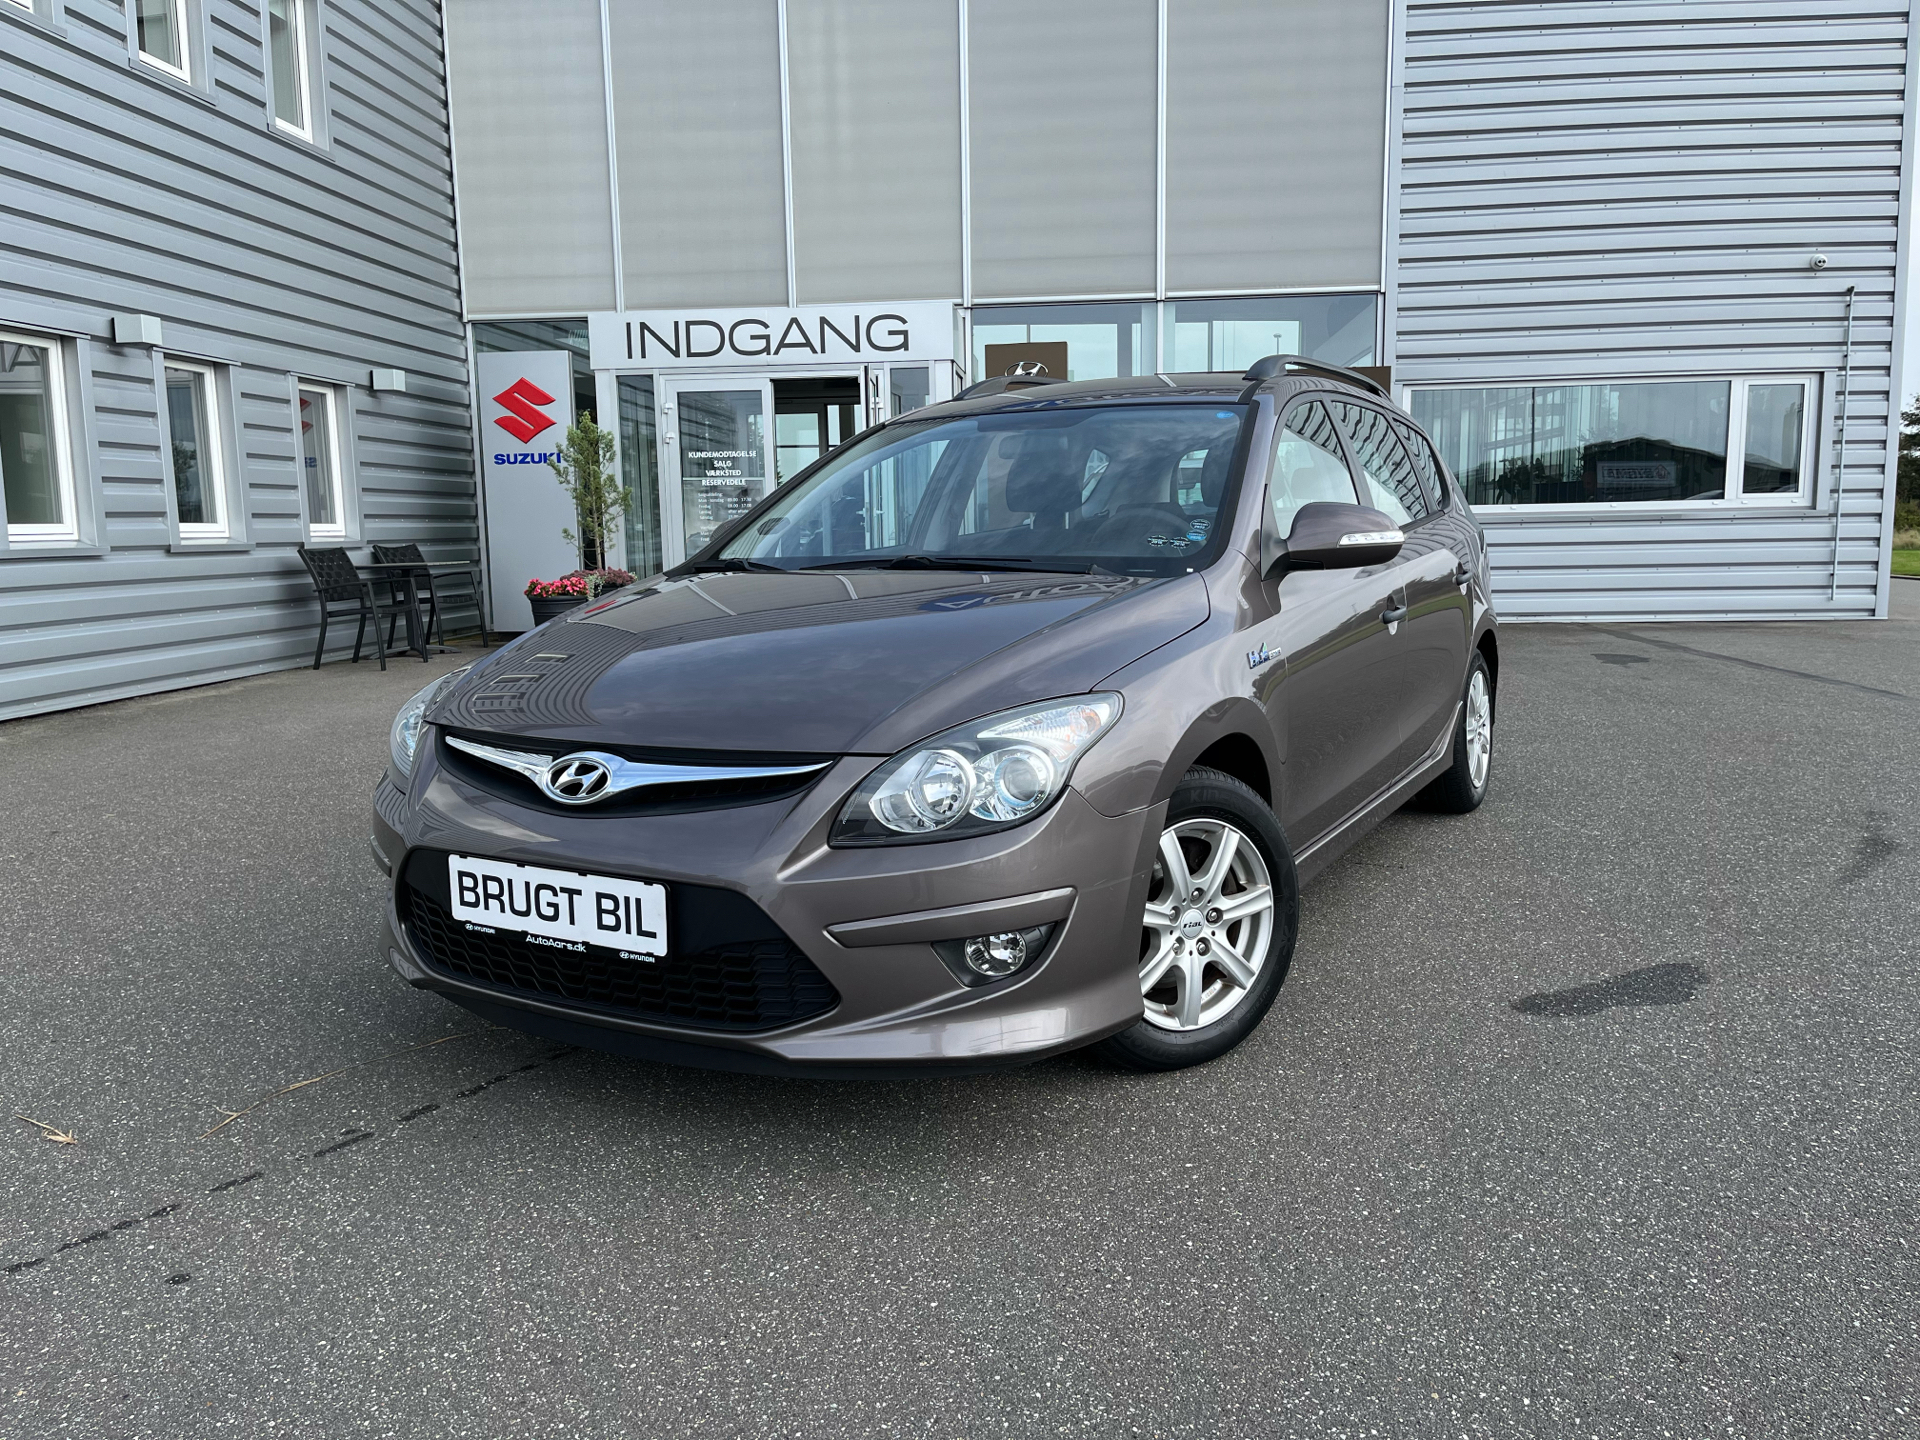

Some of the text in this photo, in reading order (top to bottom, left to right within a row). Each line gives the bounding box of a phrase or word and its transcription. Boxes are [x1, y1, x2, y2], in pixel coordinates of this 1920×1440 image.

[625, 314, 910, 360] INDGANG
[493, 452, 562, 466] SUZUKI
[688, 450, 757, 458] KUNDEMODTAGELSE
[457, 870, 657, 939] BRUGT BIL
[473, 926, 496, 934] HYUNDAI
[525, 934, 587, 953] AutoAars.dk
[629, 953, 656, 963] HYUNDAI
